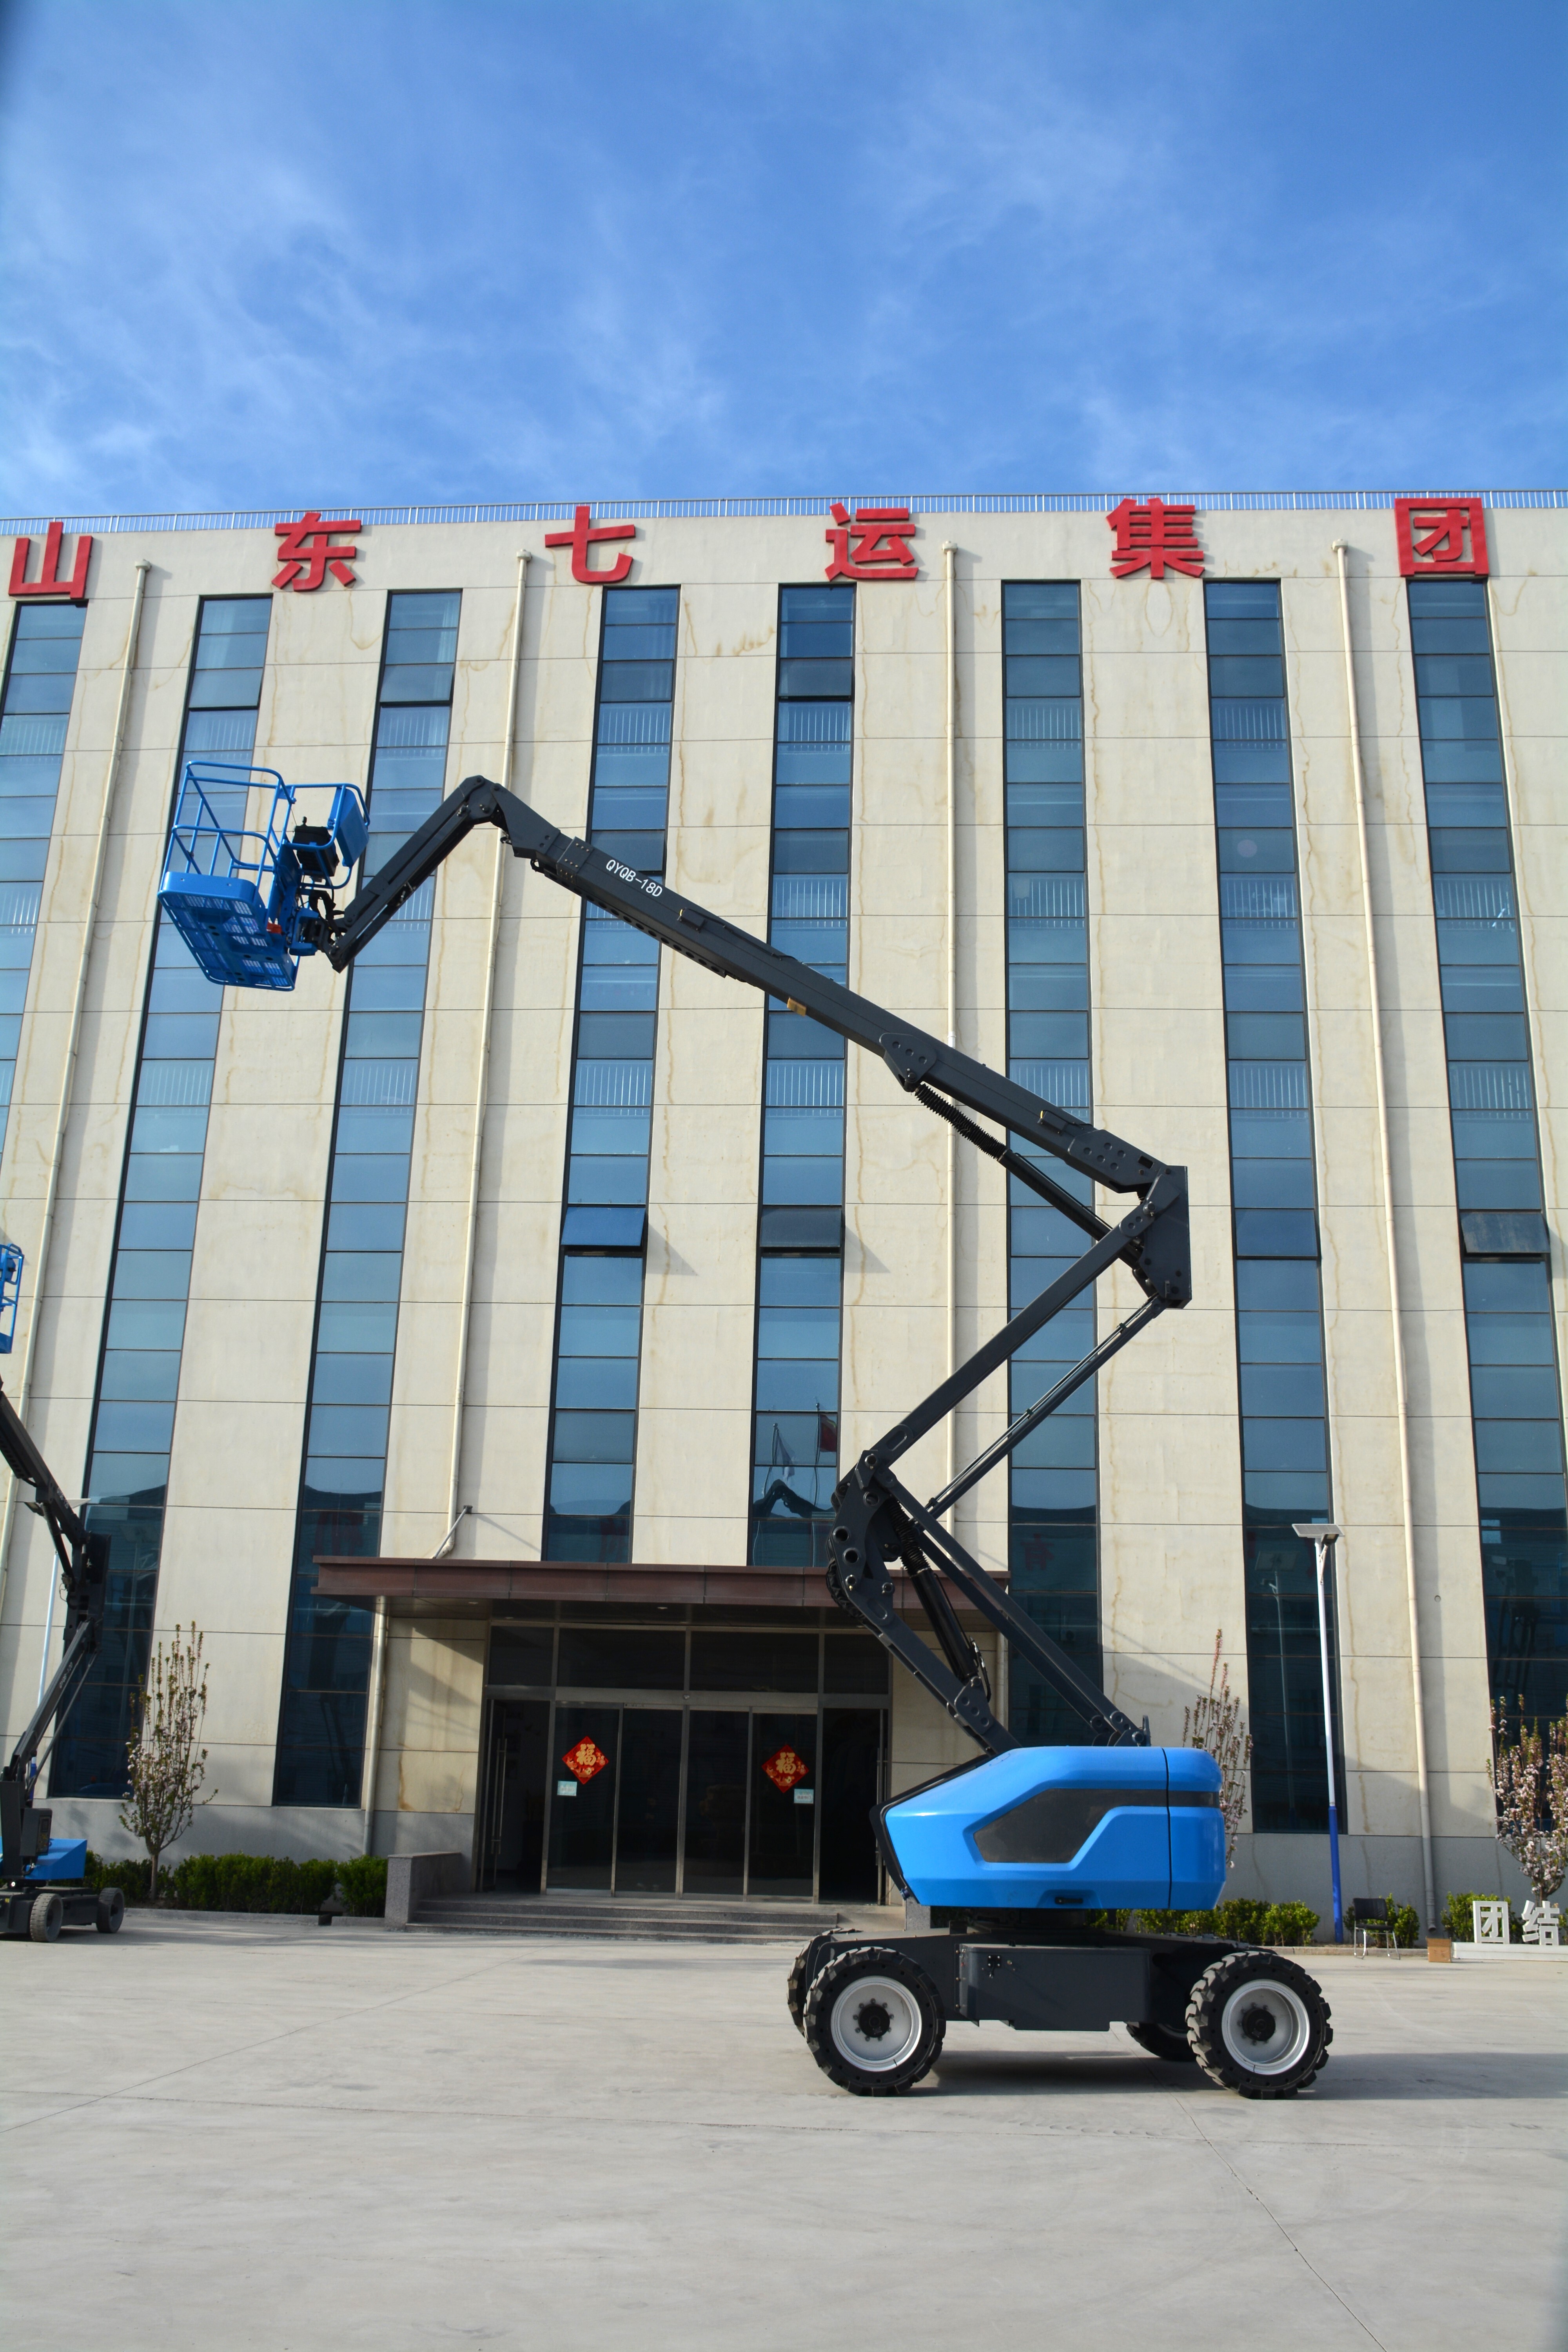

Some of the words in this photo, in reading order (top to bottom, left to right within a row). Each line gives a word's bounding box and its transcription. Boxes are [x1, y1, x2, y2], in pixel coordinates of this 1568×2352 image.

[9, 498, 1489, 599] 山东七运集团
[606, 859, 662, 897] QYQB-18D
[576, 1744, 597, 1766] 福
[775, 1752, 797, 1775] 福
[1473, 1900, 1560, 1945] 团结
